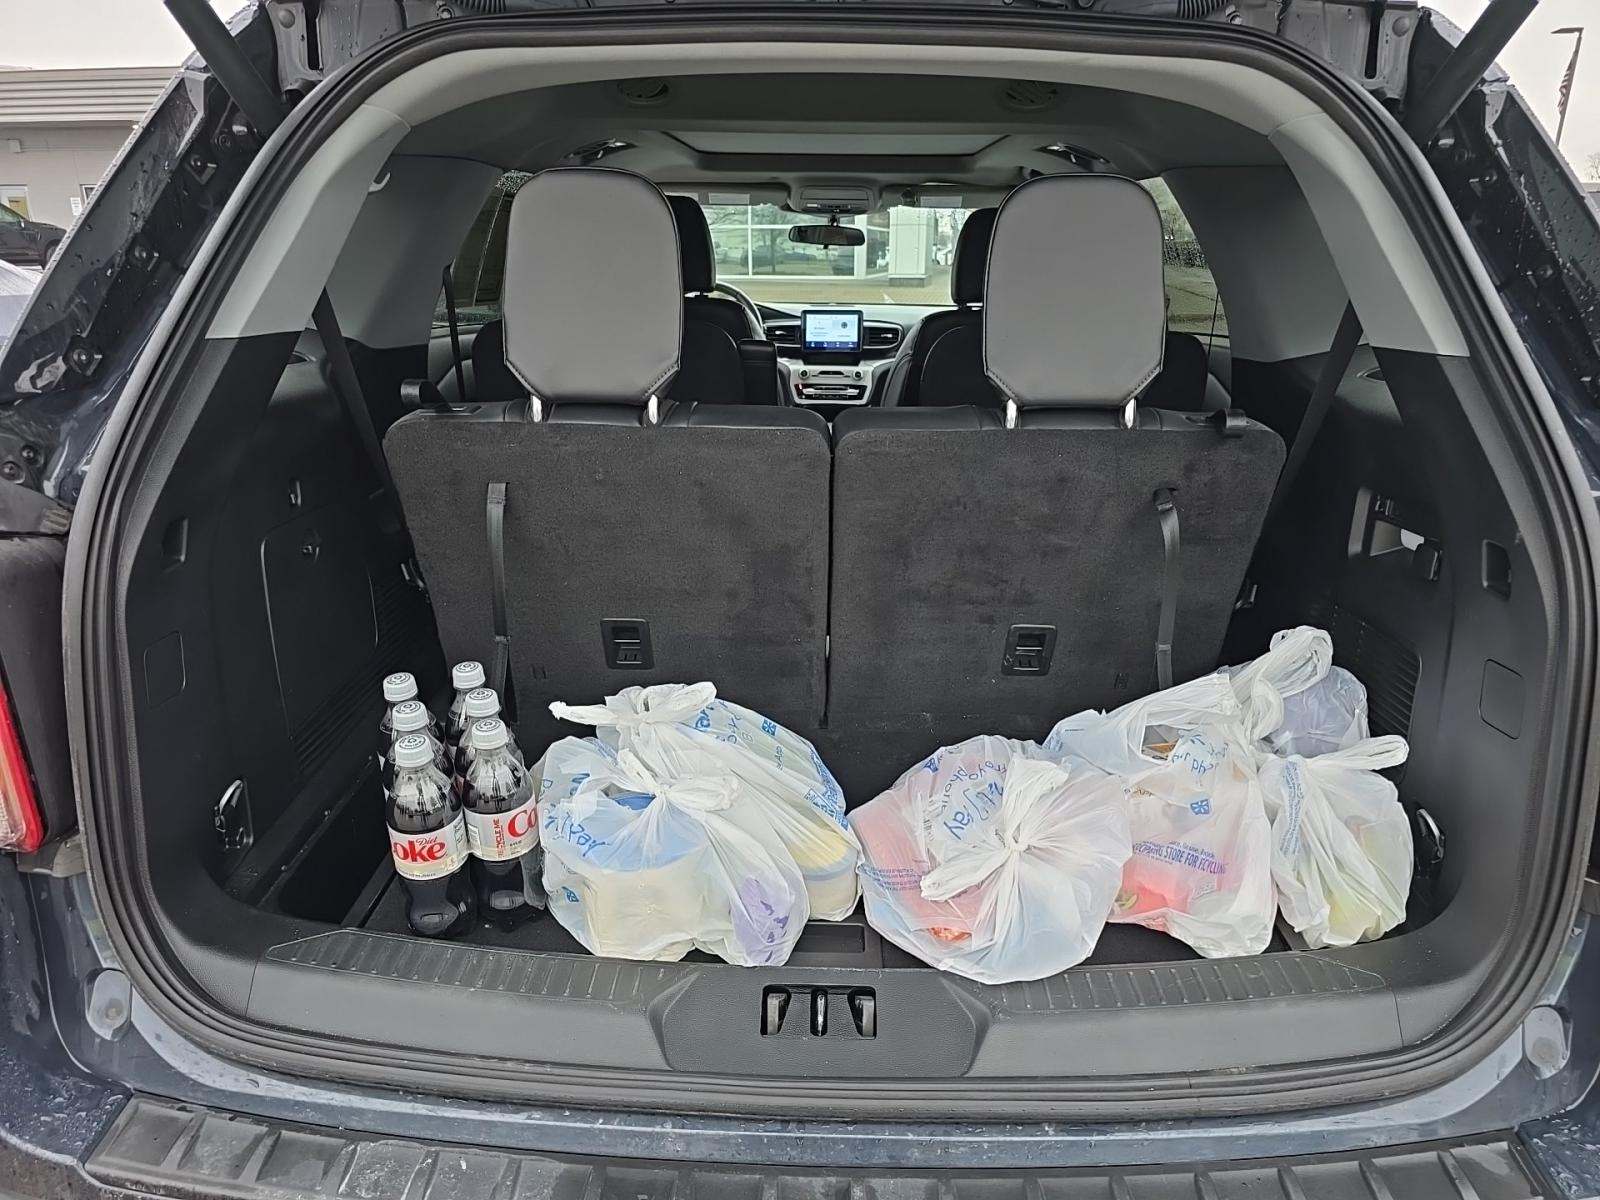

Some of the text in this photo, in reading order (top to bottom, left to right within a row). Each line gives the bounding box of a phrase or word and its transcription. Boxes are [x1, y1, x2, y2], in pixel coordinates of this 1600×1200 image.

[393, 840, 447, 862] oke
[416, 836, 438, 847] Diet
[1164, 845, 1185, 863] STORE
[1184, 852, 1198, 869] FOR
